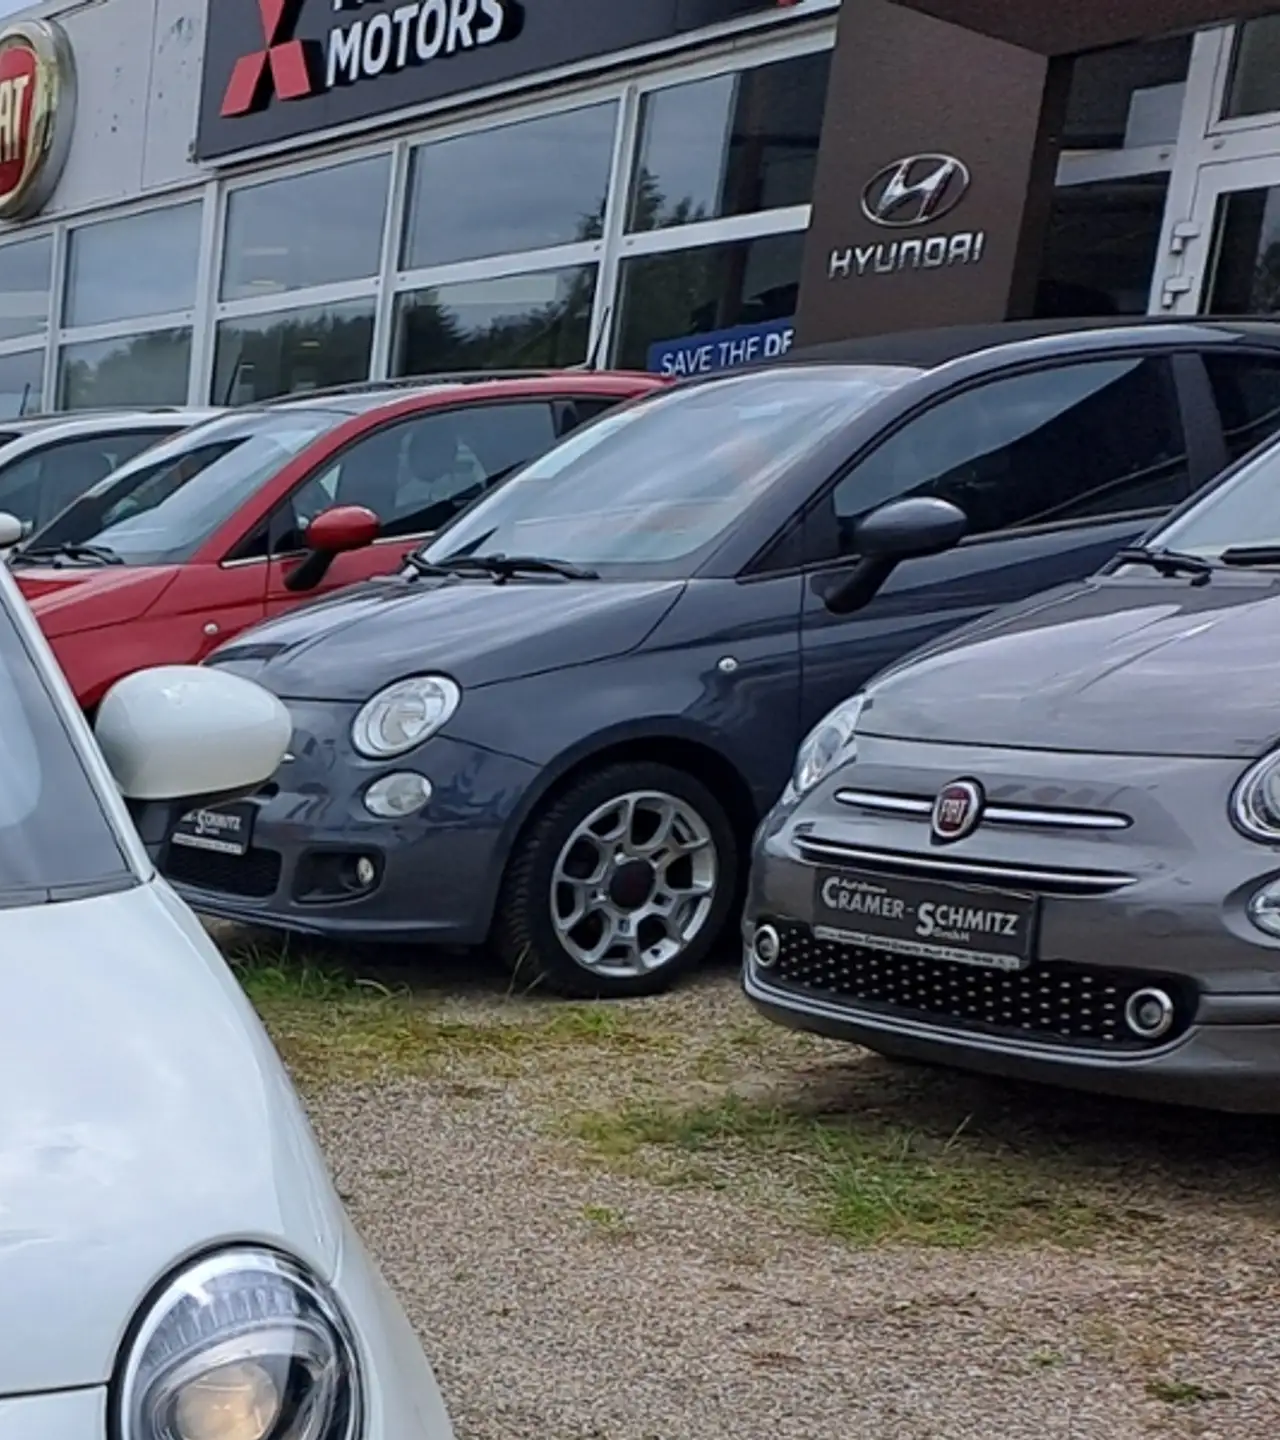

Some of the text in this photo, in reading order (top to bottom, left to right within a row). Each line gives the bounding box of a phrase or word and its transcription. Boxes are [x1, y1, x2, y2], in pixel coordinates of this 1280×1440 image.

[326, 0, 503, 87] MOTORS
[828, 231, 984, 279] HYUNDAI
[660, 344, 714, 376] SAVE
[941, 799, 969, 824] FIAT
[821, 876, 1020, 936] CRAMER-SCHMITZ
